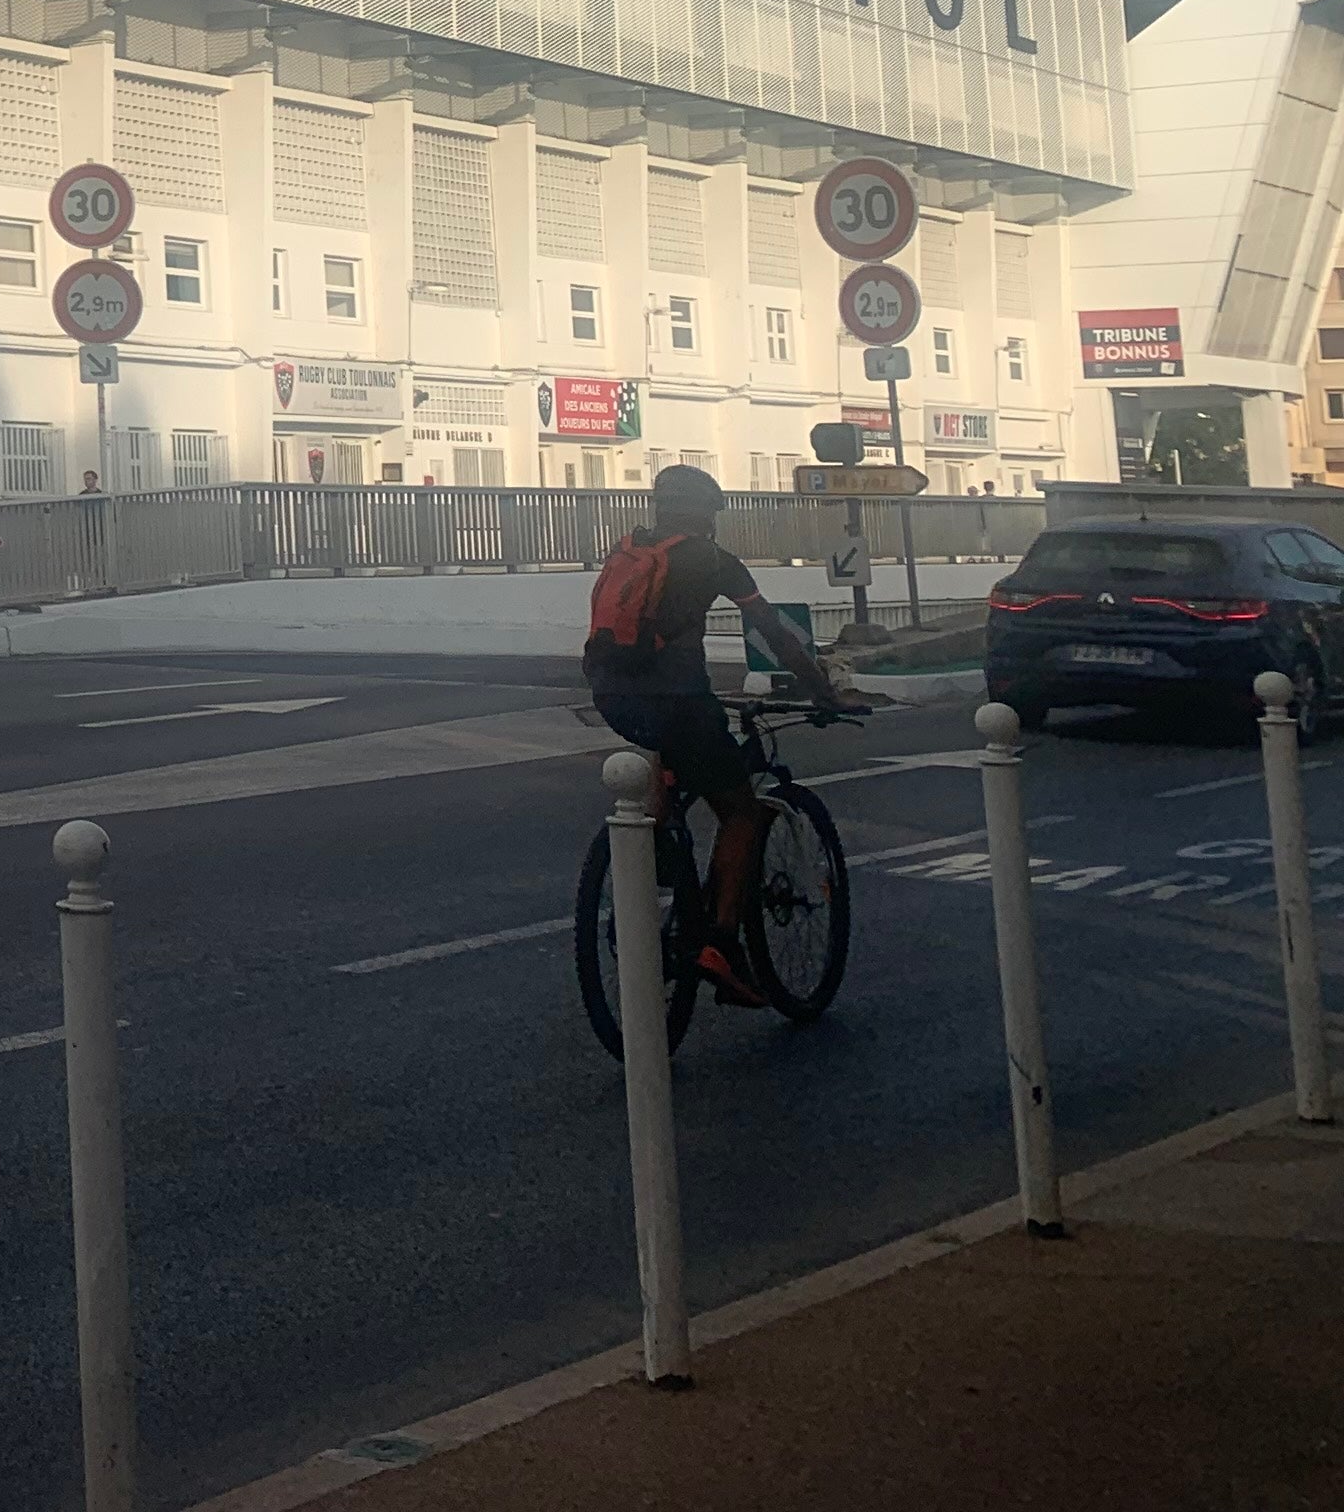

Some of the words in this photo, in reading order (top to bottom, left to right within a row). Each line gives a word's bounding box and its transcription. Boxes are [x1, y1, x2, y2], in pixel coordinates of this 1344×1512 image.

[68, 188, 115, 223] 30
[835, 185, 896, 232] 30
[1092, 327, 1168, 343] TRIBUNE
[1094, 345, 1171, 361] BONNUS
[298, 365, 325, 384] RUGBY
[327, 367, 347, 386] CLUB
[349, 369, 397, 389] TOULONNAIS
[570, 383, 601, 396] AMICALE
[564, 400, 579, 412] DES
[579, 401, 609, 414] ANCIENS
[559, 417, 590, 430] JOUEURS
[591, 418, 602, 430] DU
[943, 413, 960, 437] RCT
[962, 414, 988, 439] STORE
